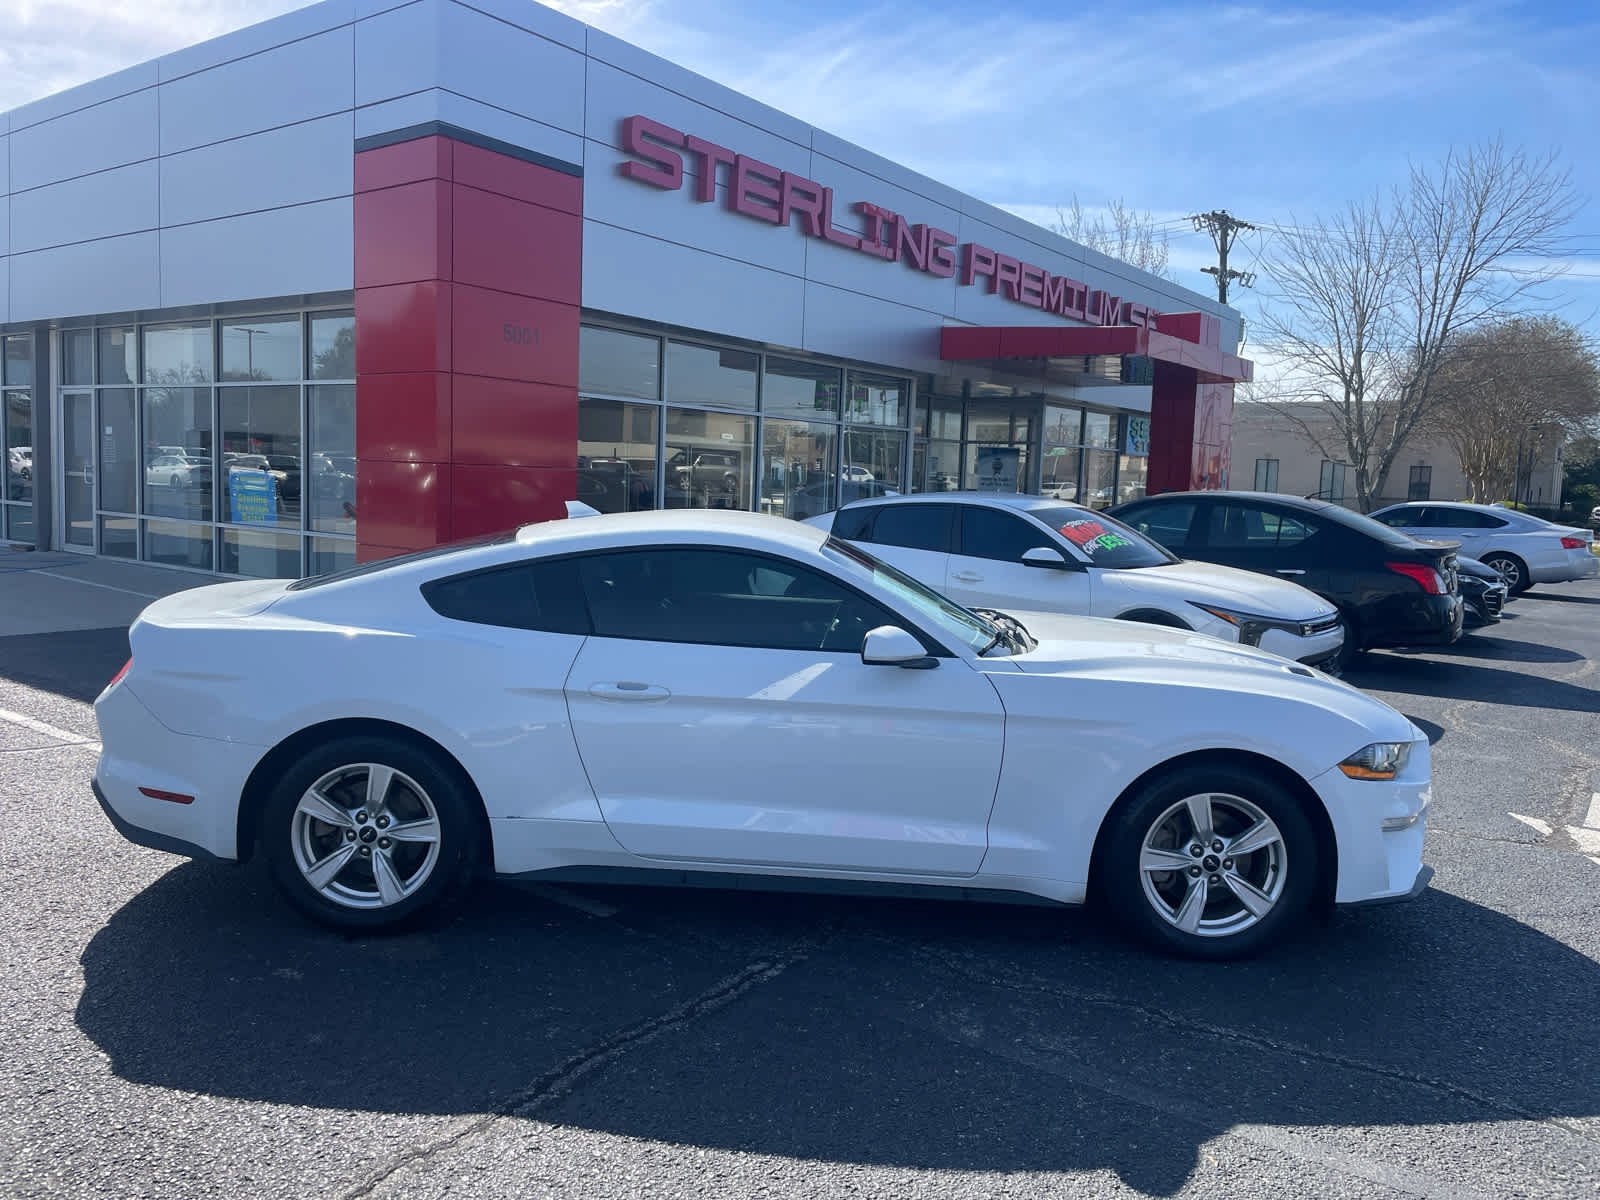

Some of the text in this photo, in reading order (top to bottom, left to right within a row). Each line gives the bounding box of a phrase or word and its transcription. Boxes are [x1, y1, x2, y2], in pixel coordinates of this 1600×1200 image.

[620, 114, 1159, 329] STERLING PREMIUM SE
